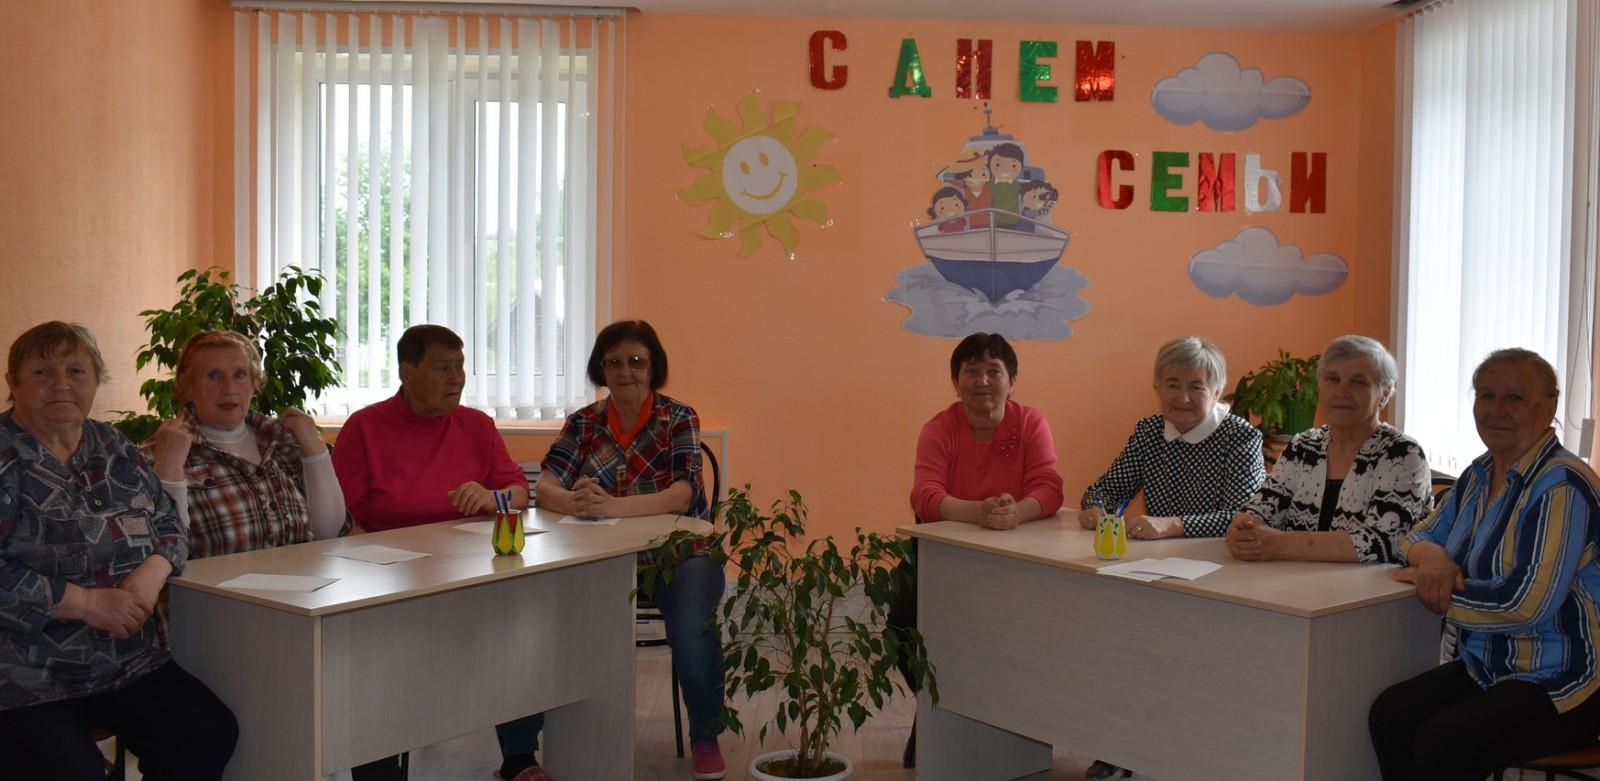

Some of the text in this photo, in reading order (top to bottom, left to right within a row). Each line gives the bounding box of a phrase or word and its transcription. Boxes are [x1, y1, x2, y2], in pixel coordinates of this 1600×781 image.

[809, 30, 1116, 102] С ДНЕМ
[1096, 150, 1327, 214] СЕМЬИ
